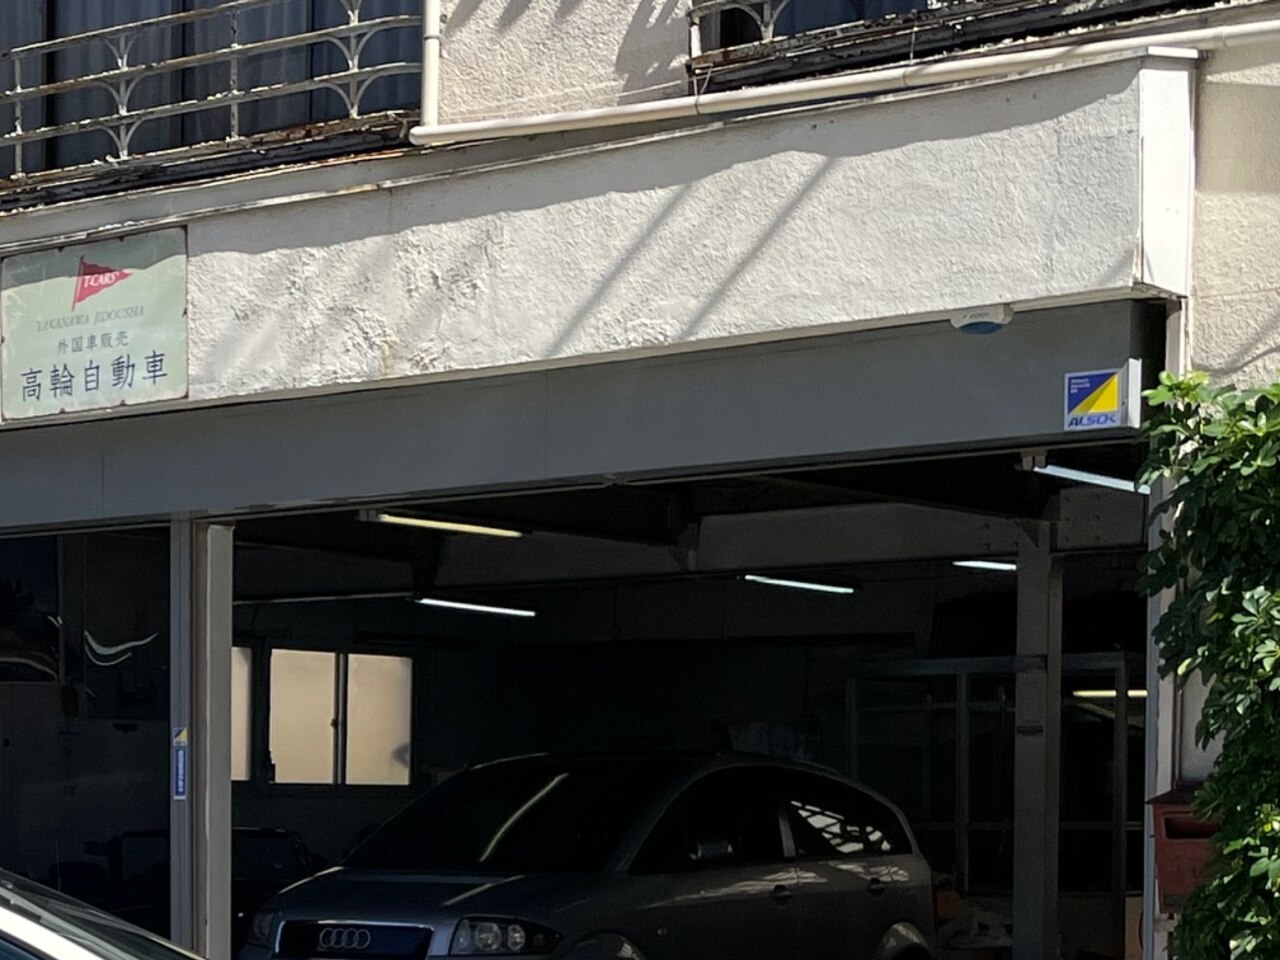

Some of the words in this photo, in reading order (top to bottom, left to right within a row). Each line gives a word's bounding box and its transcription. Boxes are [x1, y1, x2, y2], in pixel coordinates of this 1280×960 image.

[56, 331, 129, 355] 外国車販売
[21, 349, 168, 402] 高輪自動車
[1067, 414, 1116, 428] ALSOK
